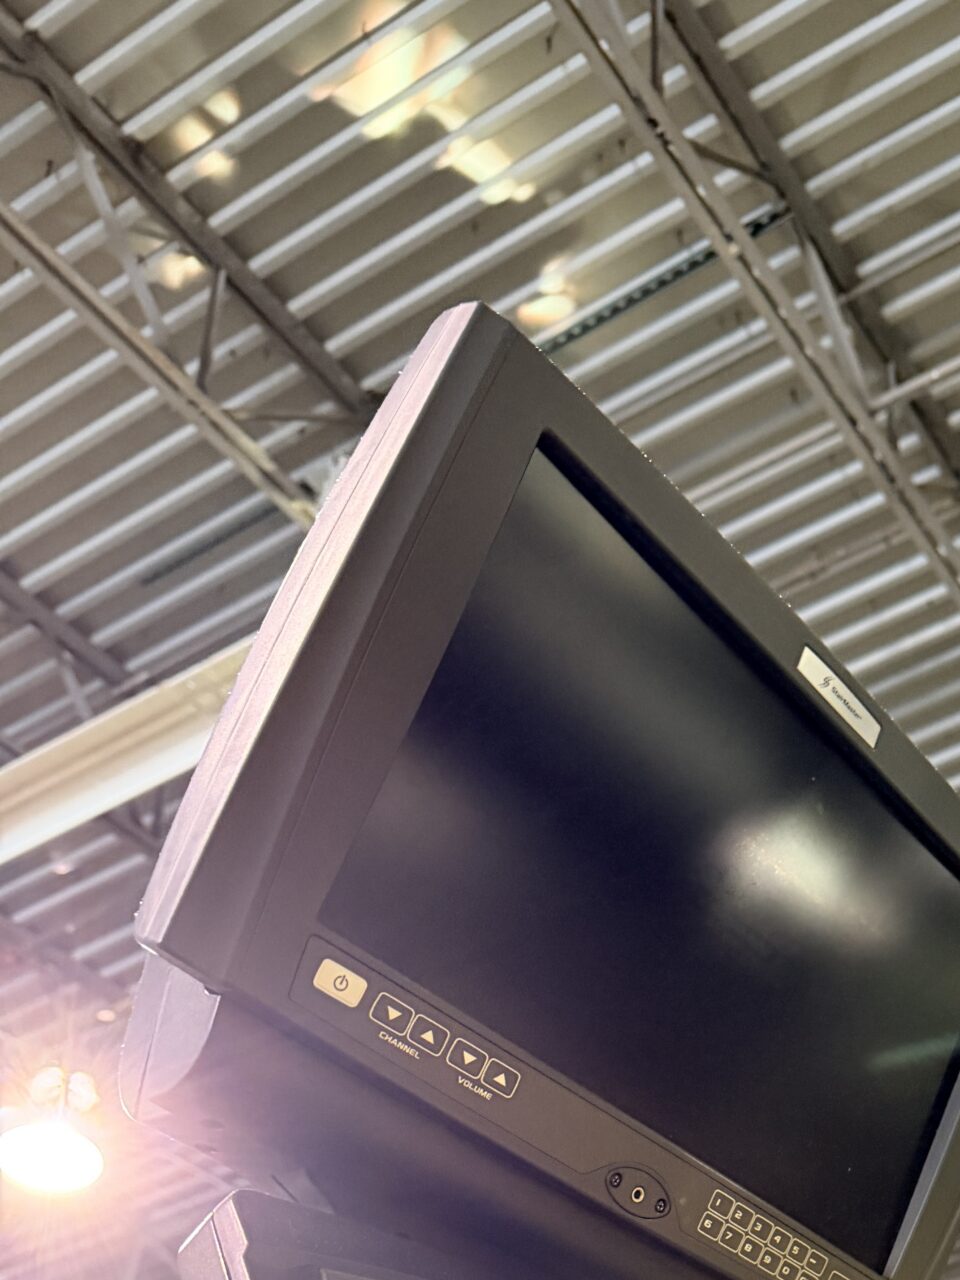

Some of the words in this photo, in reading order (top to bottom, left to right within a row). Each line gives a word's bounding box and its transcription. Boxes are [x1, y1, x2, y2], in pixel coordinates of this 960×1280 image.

[378, 1030, 421, 1061] CHANNEL
[457, 1075, 493, 1101] VOLUME
[703, 1219, 713, 1229] 6
[725, 1231, 733, 1240] 7
[744, 1243, 753, 1253] 8
[763, 1255, 772, 1265] 9
[734, 1210, 743, 1220] 2
[754, 1222, 762, 1232] 3
[773, 1235, 782, 1244] 4
[791, 1245, 800, 1255] 5
